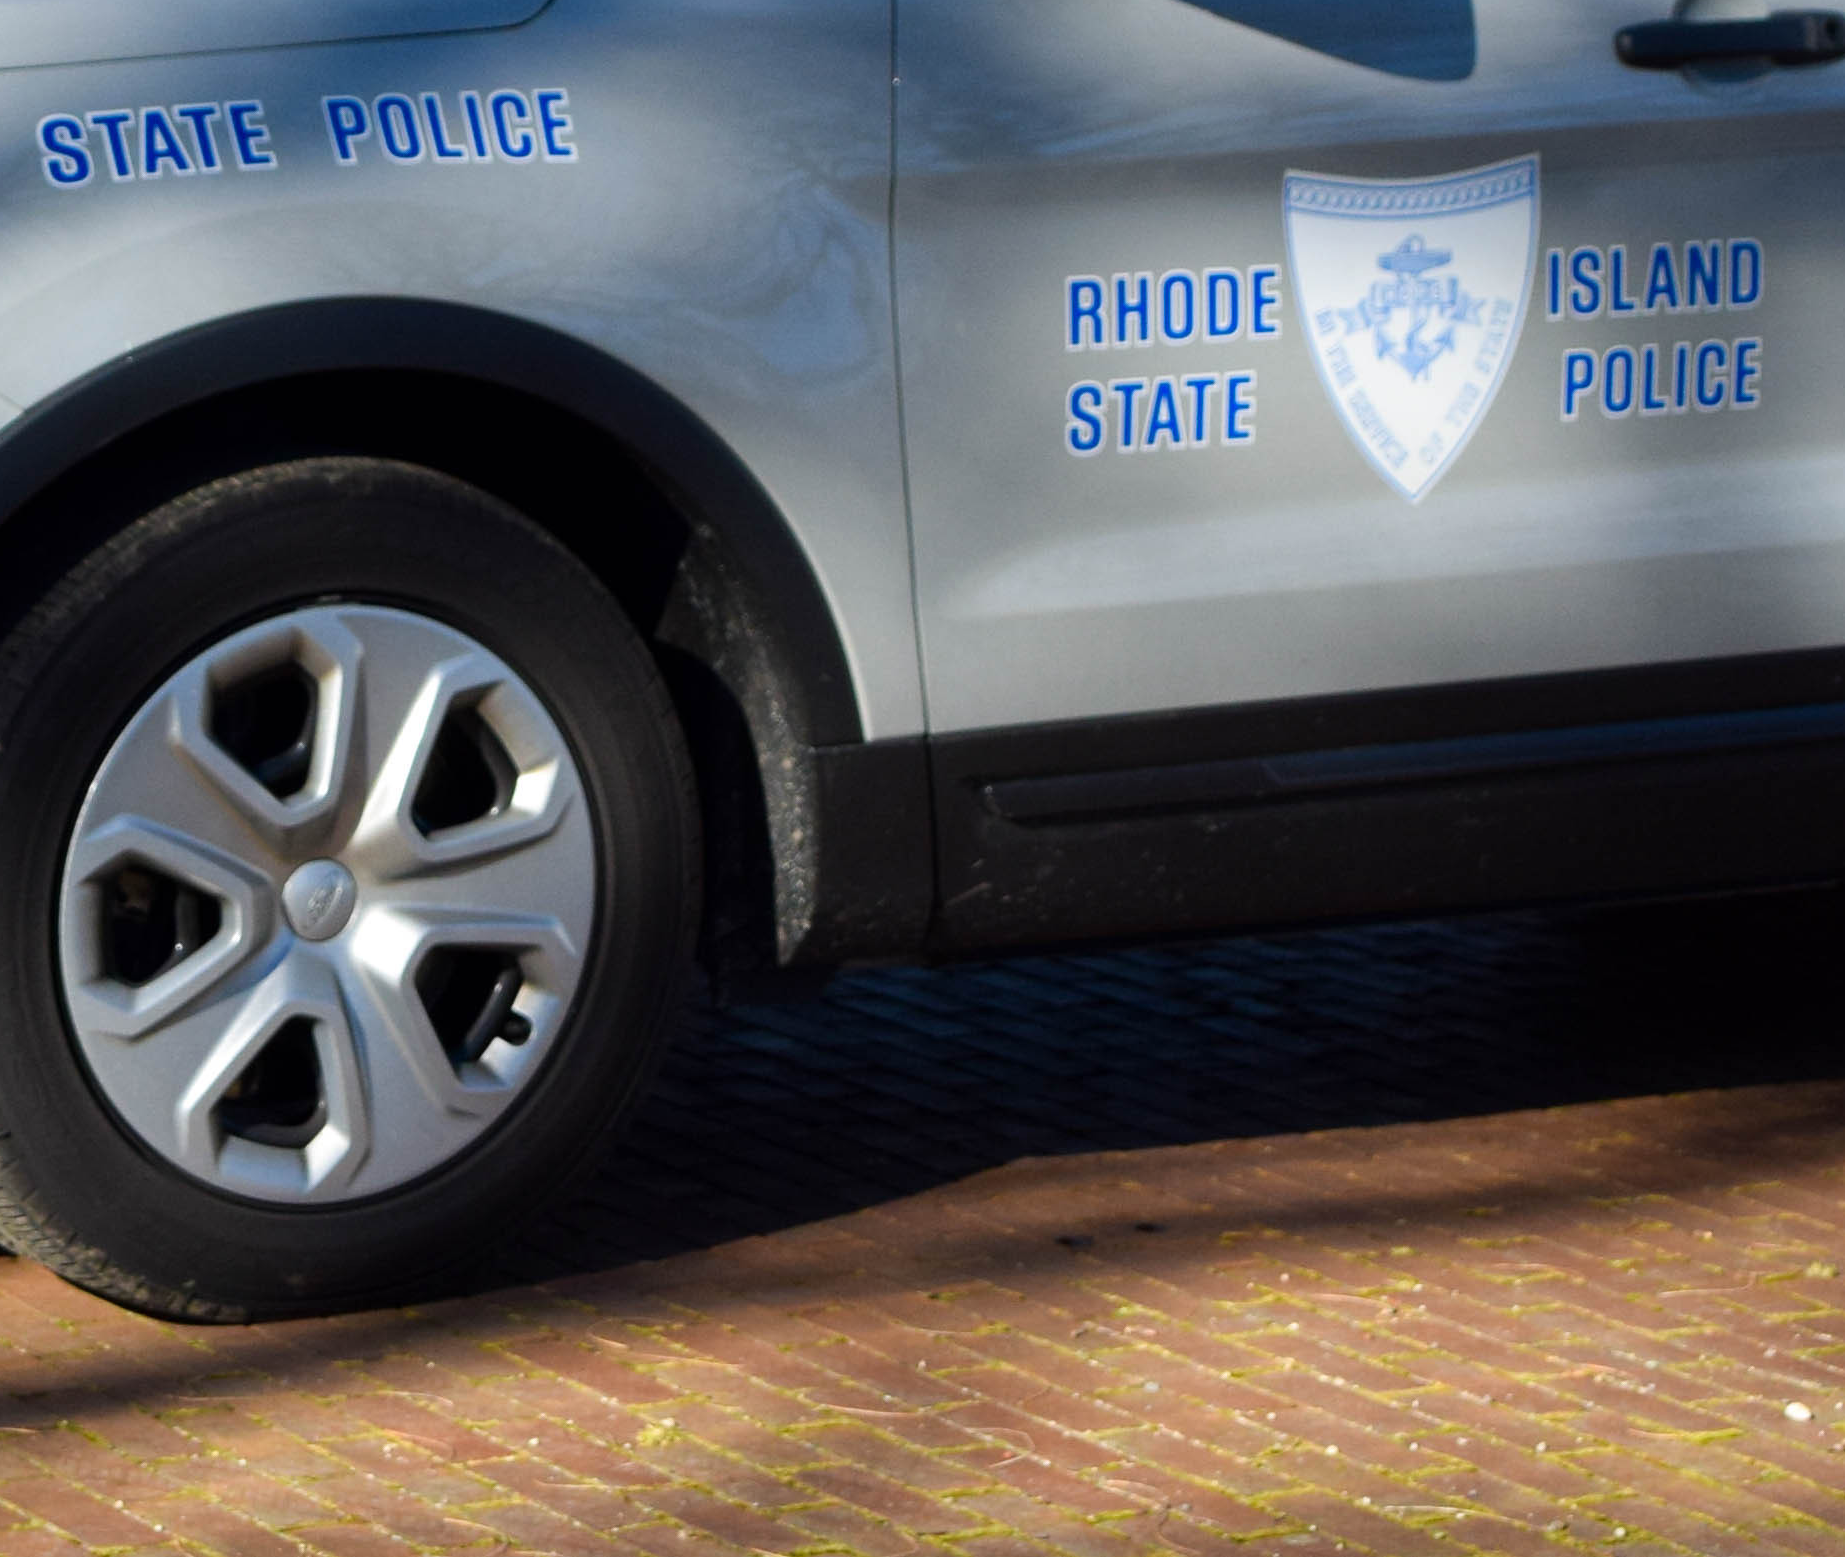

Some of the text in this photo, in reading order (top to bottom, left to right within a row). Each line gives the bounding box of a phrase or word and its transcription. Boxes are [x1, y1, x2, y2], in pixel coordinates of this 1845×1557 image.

[39, 88, 575, 186] STATE POLICE
[1067, 240, 1762, 348] RHODE ISLAND
[1067, 373, 1254, 454] STATE
[1562, 339, 1759, 417] POLICE
